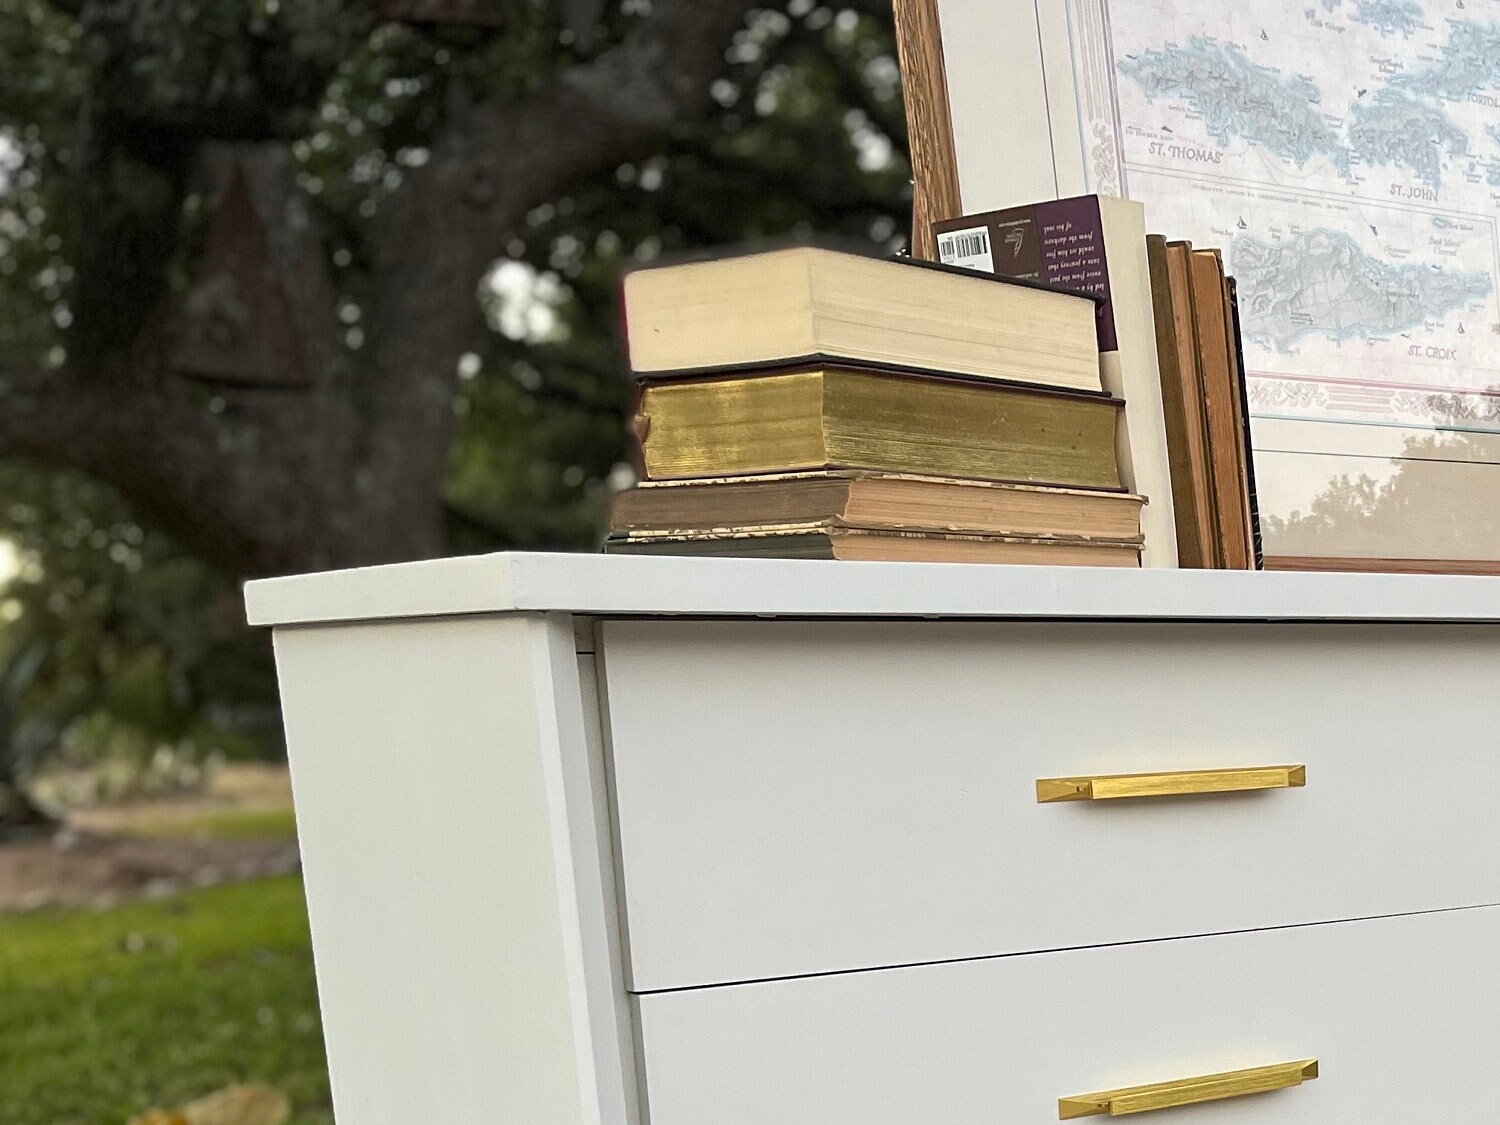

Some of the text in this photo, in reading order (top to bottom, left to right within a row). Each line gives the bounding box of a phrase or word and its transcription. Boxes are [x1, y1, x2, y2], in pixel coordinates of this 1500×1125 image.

[1148, 141, 1224, 164] ST. THOMAS
[1408, 186, 1439, 202] JOHN
[1425, 346, 1457, 361] CROIX
